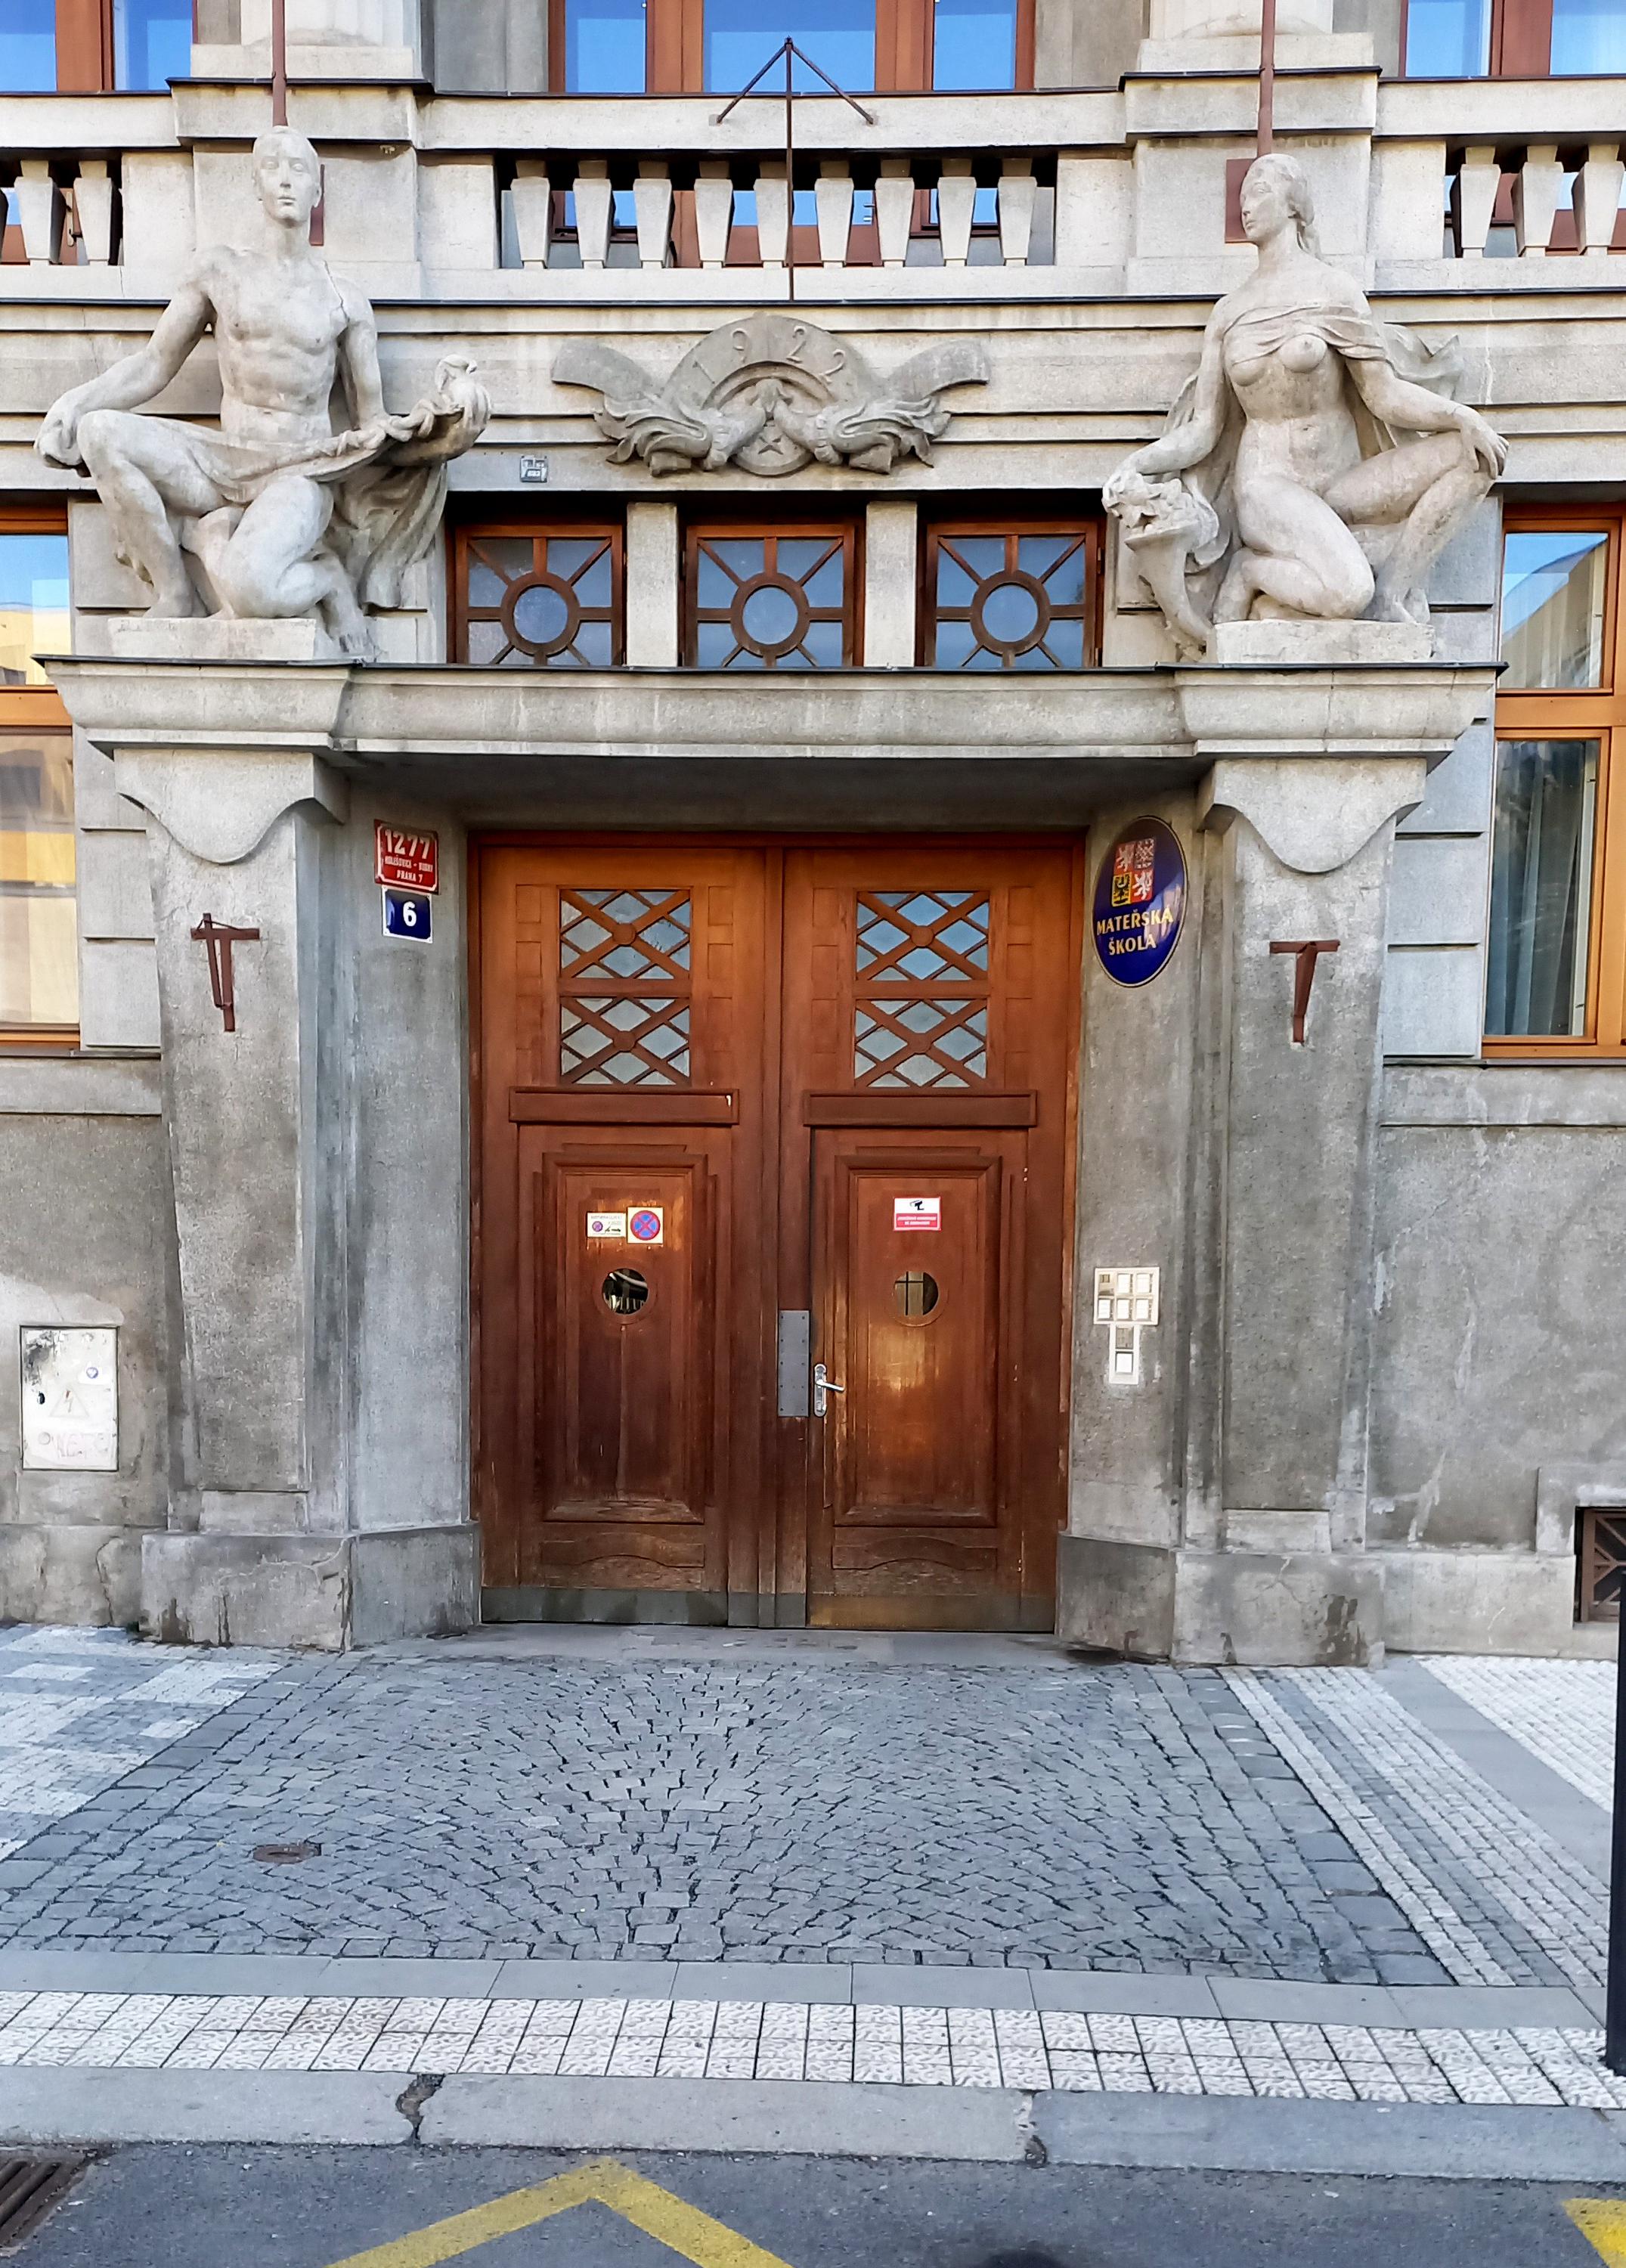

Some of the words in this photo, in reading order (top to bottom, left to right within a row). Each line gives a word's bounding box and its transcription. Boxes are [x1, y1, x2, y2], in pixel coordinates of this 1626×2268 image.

[692, 325, 846, 385] 1922
[385, 829, 431, 860] 1277
[396, 869, 417, 882] PRAHA
[418, 874, 423, 883] 7
[403, 901, 417, 927] 6
[1097, 903, 1174, 936] MATEŘSKÁ
[1108, 934, 1157, 956] ŠKOLA
